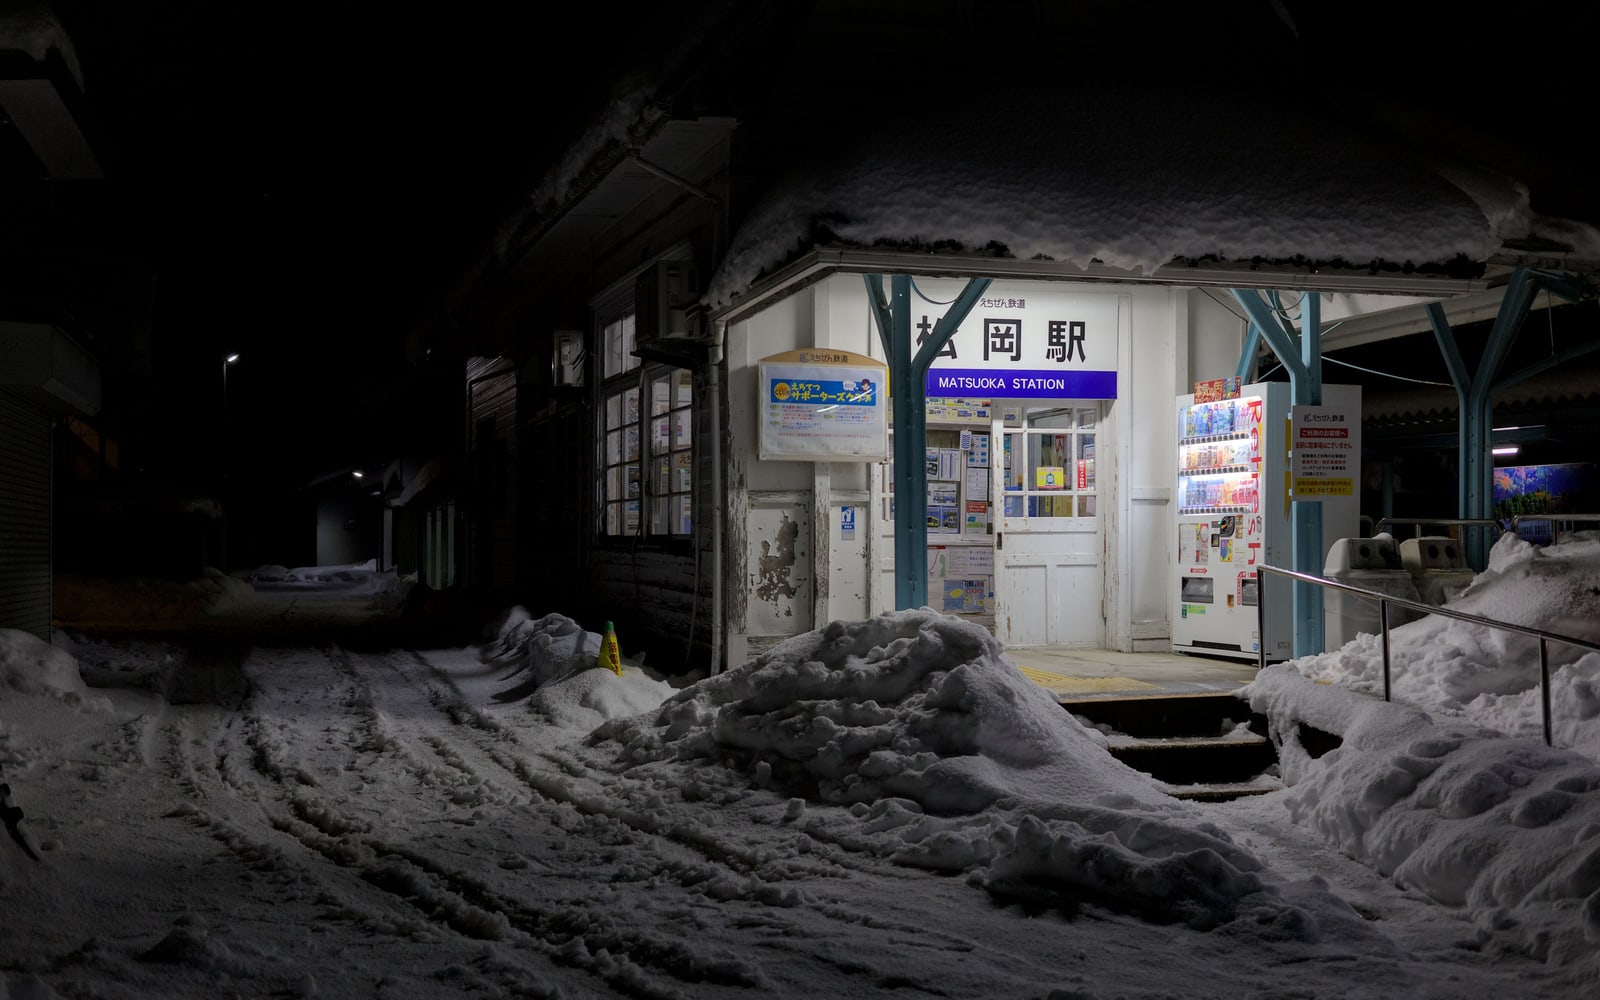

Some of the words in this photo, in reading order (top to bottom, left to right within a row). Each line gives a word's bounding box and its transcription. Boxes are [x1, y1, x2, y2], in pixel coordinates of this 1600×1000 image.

[980, 298, 1026, 309] えちぜん鉄道
[810, 354, 849, 363] えちぜん鉄道
[791, 382, 821, 391] えちてつ
[939, 377, 1006, 389] MATSUOKA
[1012, 378, 1065, 390] STATION
[1312, 414, 1345, 422] えちぜん鉄道
